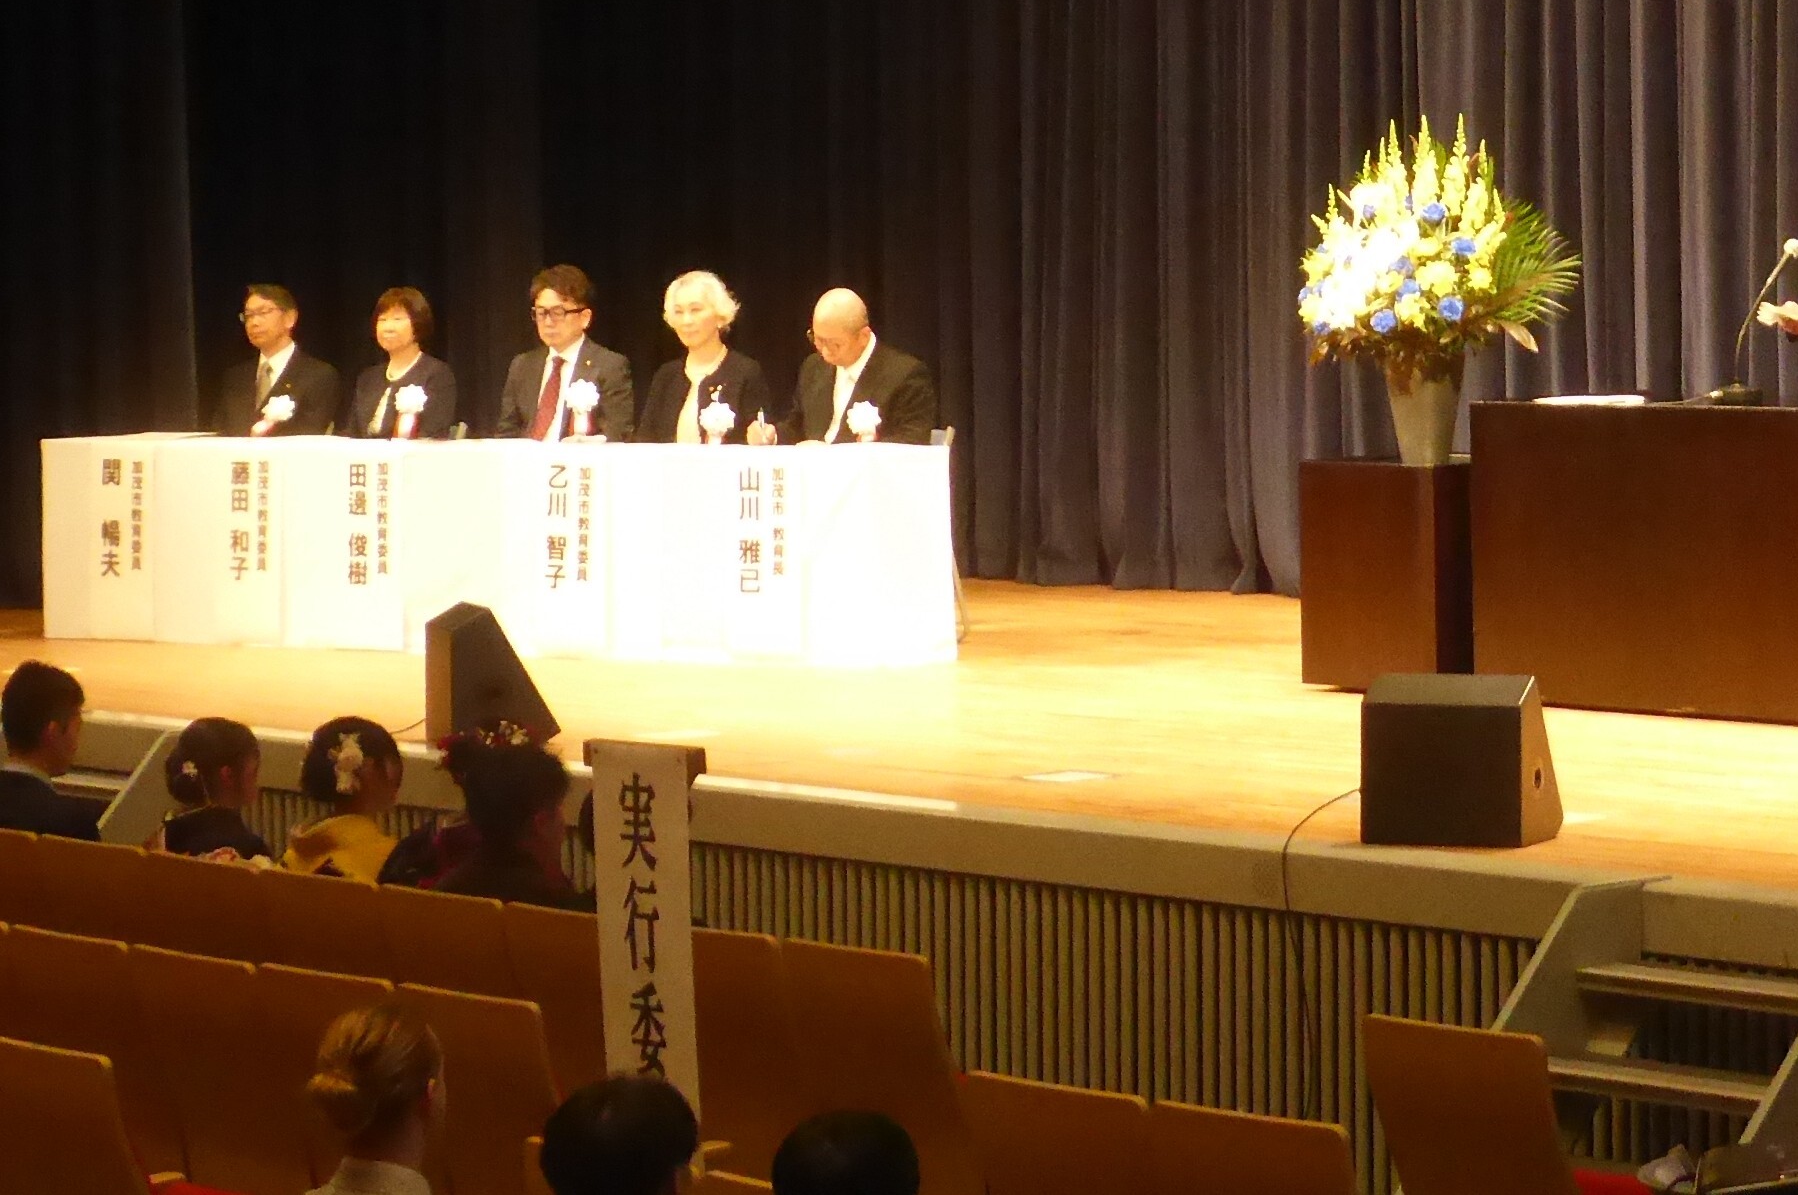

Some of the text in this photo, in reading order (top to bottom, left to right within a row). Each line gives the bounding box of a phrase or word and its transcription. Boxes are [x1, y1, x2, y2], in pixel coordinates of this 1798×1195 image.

[101, 458, 123, 486] 関
[230, 460, 251, 581] 藤田 和子
[545, 463, 569, 589] 乙川 智子
[576, 467, 592, 582] 加茂市教育委員
[739, 467, 761, 521] 山川
[772, 467, 785, 576] 加茂市 教育長
[347, 532, 369, 586] 俊樹
